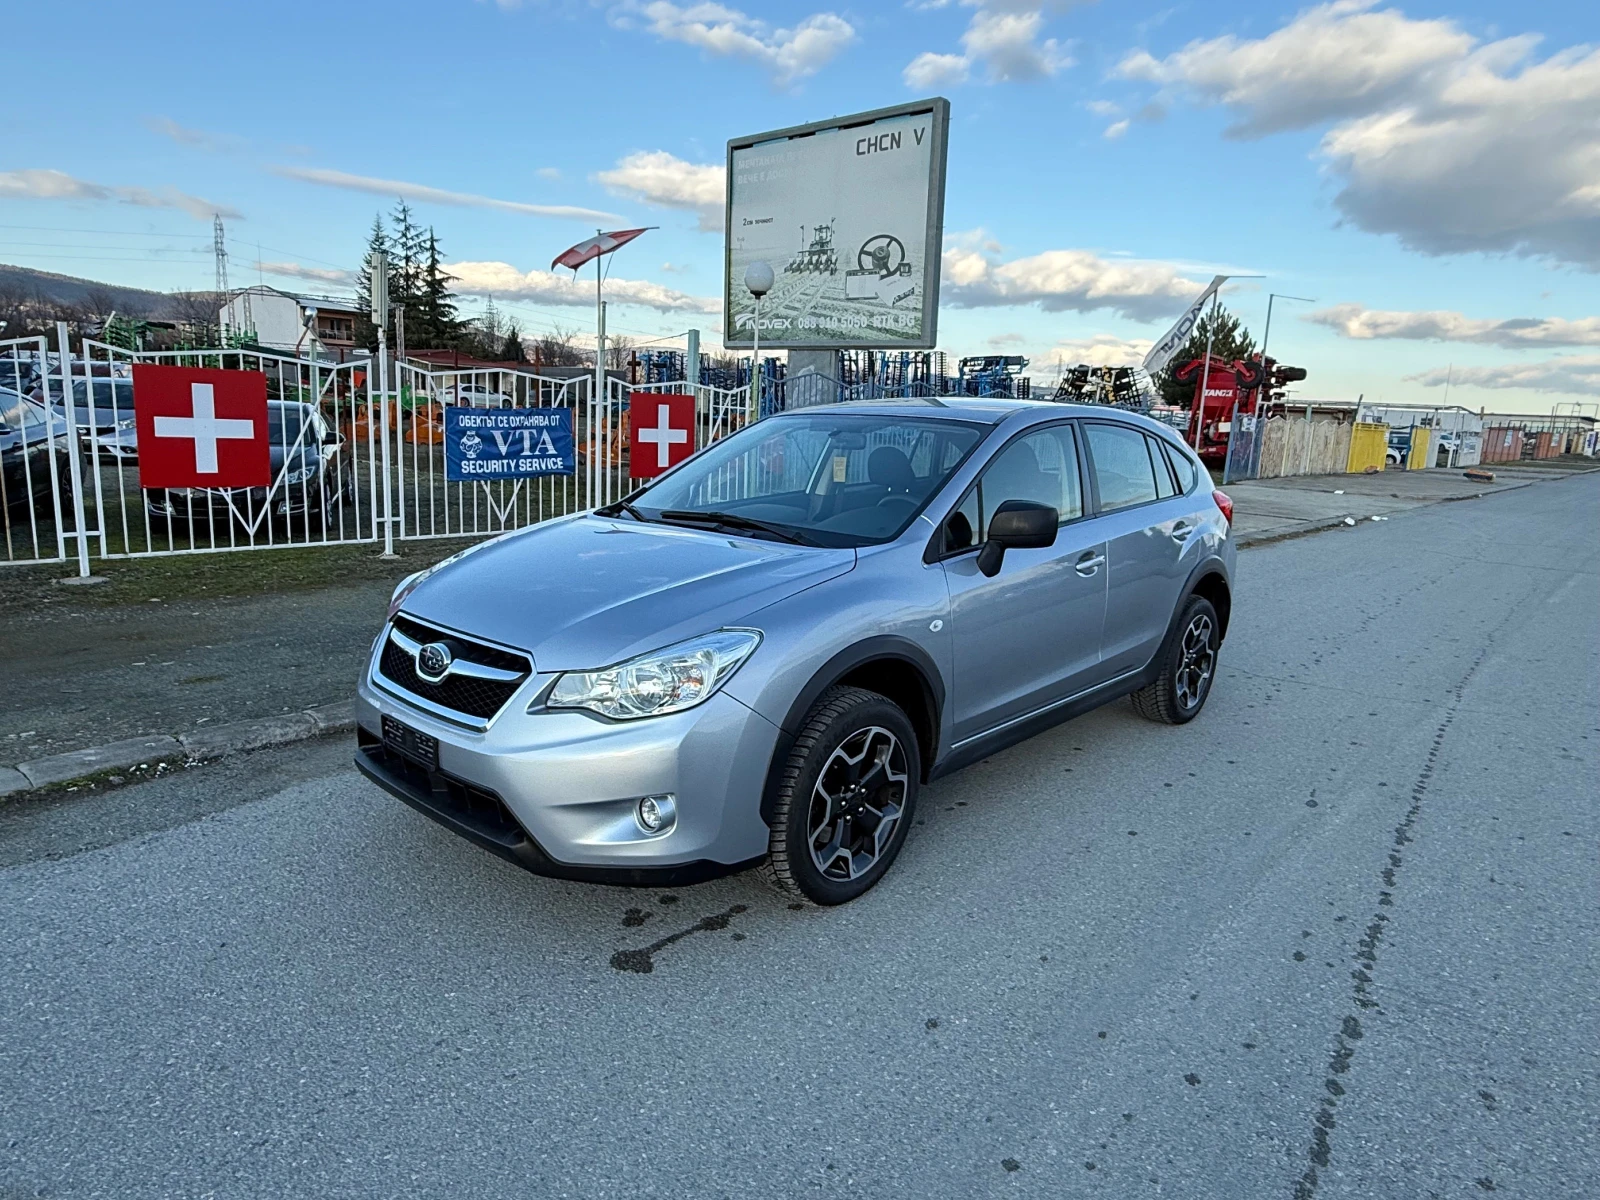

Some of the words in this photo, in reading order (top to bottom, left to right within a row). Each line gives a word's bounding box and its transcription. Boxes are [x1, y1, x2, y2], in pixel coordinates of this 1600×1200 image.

[798, 316, 816, 328] 088
[841, 315, 868, 328] 5050
[459, 415, 496, 428] ОБЕКТЪТ
[498, 416, 509, 428] СЕ
[509, 415, 550, 428] ОХРАНЯВА
[550, 415, 561, 426] ОТ
[490, 428, 558, 457] VTA
[461, 459, 516, 474] SECURITY
[519, 457, 564, 471] SERVICE
